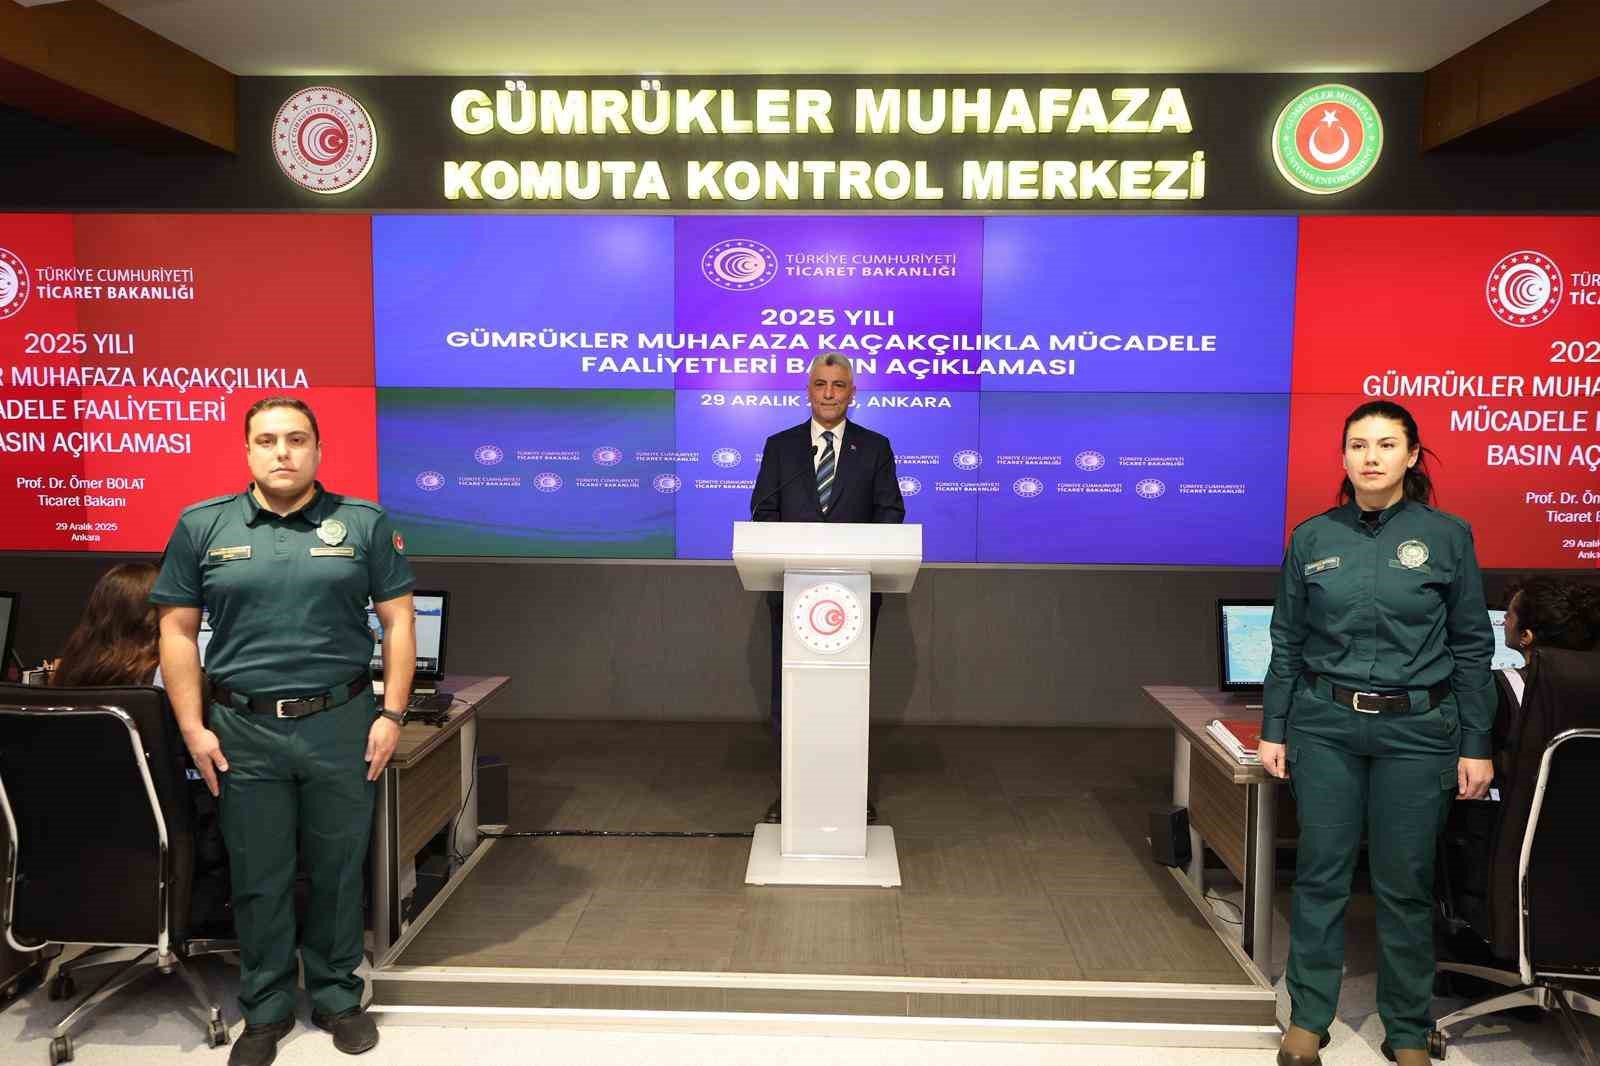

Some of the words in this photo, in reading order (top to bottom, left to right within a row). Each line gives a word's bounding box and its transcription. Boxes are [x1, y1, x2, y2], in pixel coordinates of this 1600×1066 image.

[451, 80, 833, 134] GÜMRÜKLER
[855, 87, 1193, 134] MUHAFAZA
[443, 160, 670, 200] KOMUTA
[687, 160, 944, 200] KONTROL
[962, 150, 1206, 200] MERKEZİ
[785, 252, 846, 266] TÜRKİYE
[852, 252, 957, 266] CUMHURİYETİ
[36, 265, 94, 283] TÜRKİYE
[97, 266, 193, 283] CUMHURİYETİ
[785, 265, 856, 278] TİCARET
[862, 264, 957, 278] BAKANLIĞI
[37, 283, 102, 300] TİCARET
[107, 283, 194, 301] BAKANLIĞI
[760, 308, 837, 326] 2025
[845, 309, 895, 327] YILI
[24, 333, 87, 354] 2025
[94, 333, 135, 355] YILI
[446, 328, 628, 349] GÜMRÜKLER
[638, 333, 810, 350] MUHAFAZA
[818, 333, 1041, 356] KAÇAKÇILIKLA
[1050, 331, 1217, 352] MÜCADELE
[581, 353, 777, 374] FAALİYETLERİ
[885, 358, 1076, 380] AÇIKLAMASI
[11, 366, 136, 387] MUHAFAZA
[143, 368, 309, 394] KAÇAKÇILIKLA
[1363, 370, 1525, 397] GÜMRÜKLER
[73, 395, 226, 421] FAALİYETLERİ
[701, 394, 725, 407] 29
[732, 395, 801, 407] ARALIK
[867, 396, 952, 409] ANKARA
[1450, 405, 1588, 432] MÜCADELE
[52, 432, 191, 458] AÇIKLAMASI
[1487, 444, 1561, 466] BASIN
[16, 477, 45, 490] Prof.
[49, 478, 66, 490] Dr.
[69, 475, 103, 490] Ömer
[107, 478, 145, 490] BOLAT
[37, 495, 80, 507] Ticaret
[84, 495, 126, 507] Bakanı
[1525, 491, 1557, 504] Prof.
[1560, 491, 1579, 504] Dr.
[1546, 510, 1593, 523] Ticaret
[56, 523, 67, 531] 29
[95, 523, 118, 531] 2025
[71, 533, 101, 542] Ankara
[1562, 539, 1576, 548] 29
